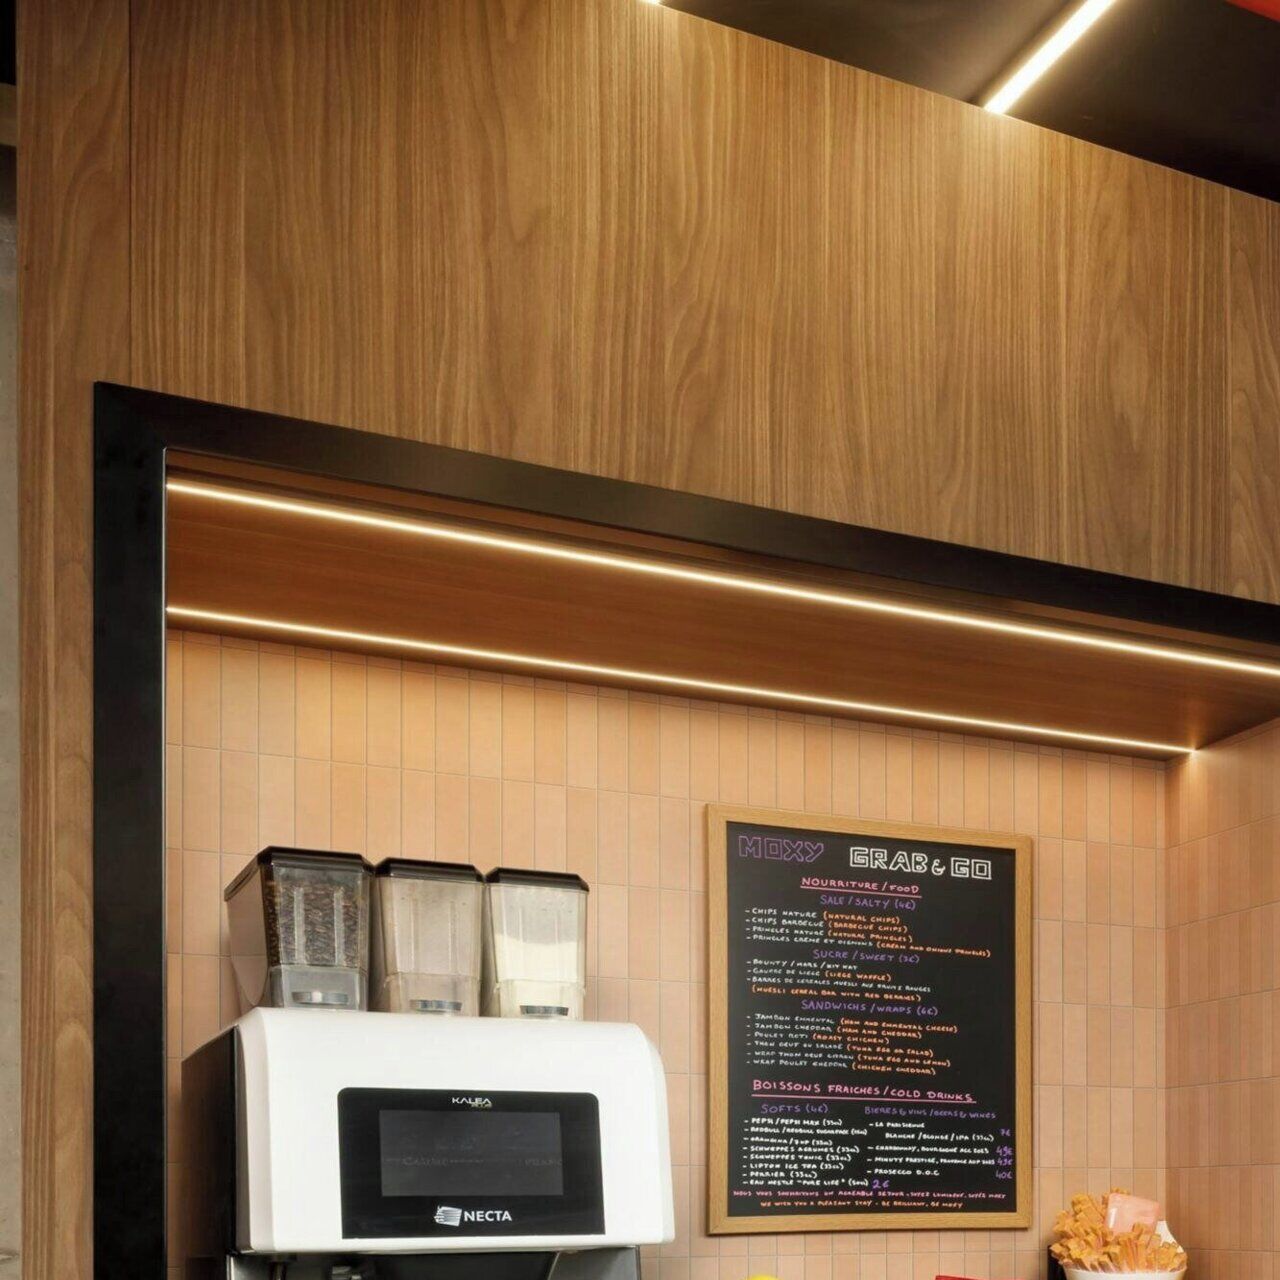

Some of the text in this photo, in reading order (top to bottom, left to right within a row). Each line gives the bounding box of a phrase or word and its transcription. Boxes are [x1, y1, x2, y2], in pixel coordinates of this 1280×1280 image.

[738, 835, 824, 862] MOXY
[850, 846, 928, 873] GRAB
[950, 857, 992, 880] GO
[801, 877, 920, 894] NOURRITURE FOOD
[854, 898, 890, 910] SALTY
[752, 907, 901, 924] CHIPS NATURE (NATURAL CHIPS)
[752, 917, 778, 925] CHIPS
[782, 919, 824, 927] BARBECUE
[878, 925, 908, 933] CHIPS)
[752, 925, 789, 934] PRINGLES
[753, 934, 790, 942] PRINGLES
[812, 949, 849, 959] SUCRE
[860, 952, 894, 961] SWEET
[753, 959, 787, 967] BOUNTY
[856, 973, 891, 982] WAFFLE)
[800, 1000, 867, 1011] SANDWICHS
[877, 1006, 912, 1014] WRAPS
[754, 1013, 790, 1021] JAMBON
[752, 1079, 973, 1102] BOISSONS FRAICHES COLD DRINKS
[761, 1103, 801, 1114] SOFTS
[464, 1211, 512, 1221] NECTA
